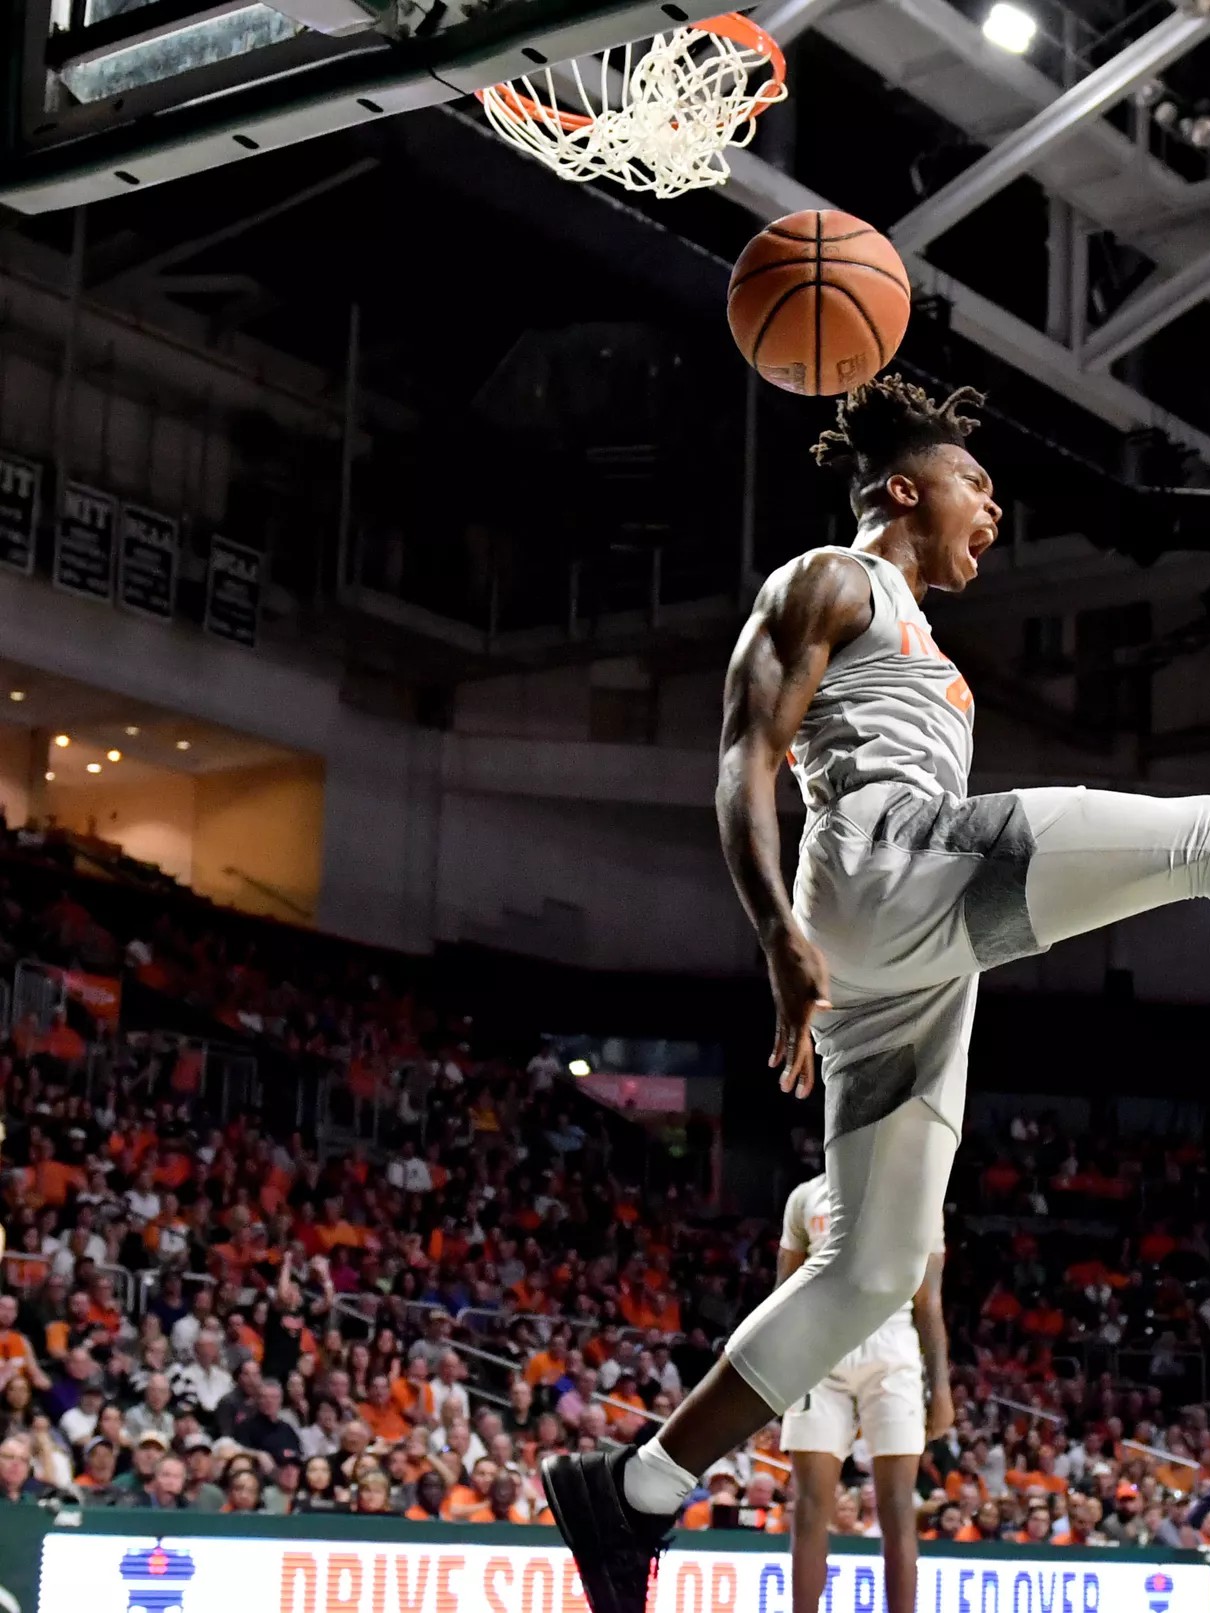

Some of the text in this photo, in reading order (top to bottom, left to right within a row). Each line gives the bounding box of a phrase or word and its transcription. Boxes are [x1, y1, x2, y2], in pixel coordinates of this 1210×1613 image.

[280, 1551, 465, 1613] DRIVE
[676, 1560, 737, 1613] OR
[1013, 1570, 1100, 1613] OVER
